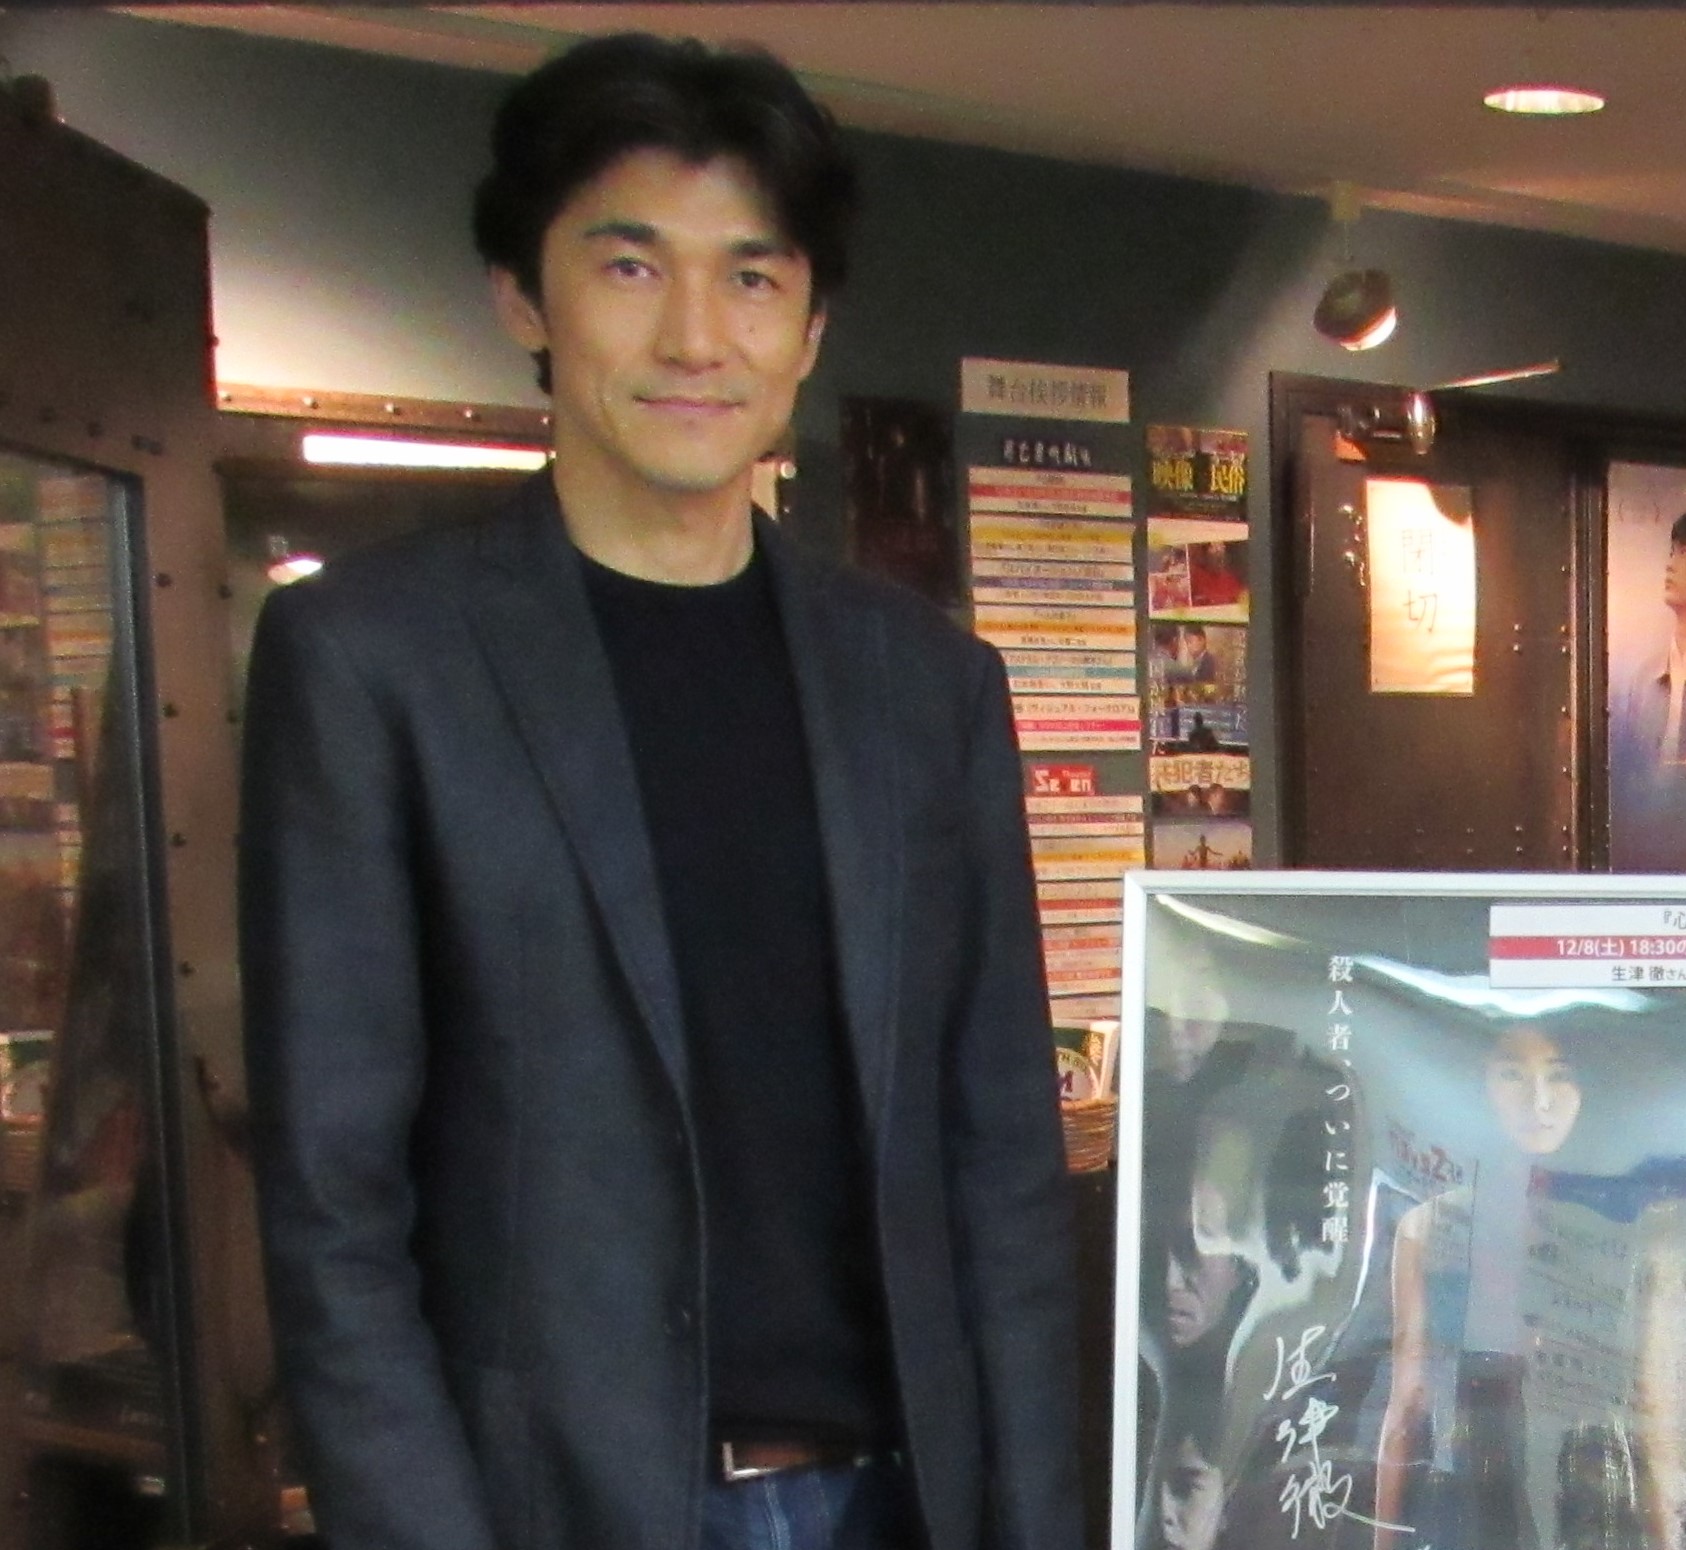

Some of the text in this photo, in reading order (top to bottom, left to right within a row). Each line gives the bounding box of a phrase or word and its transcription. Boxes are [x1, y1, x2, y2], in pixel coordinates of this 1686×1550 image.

[1557, 938, 1625, 958] 12/8(土)
[1611, 965, 1645, 982] 生津
[1320, 955, 1354, 1243] 殺人者、ついに覚醒
